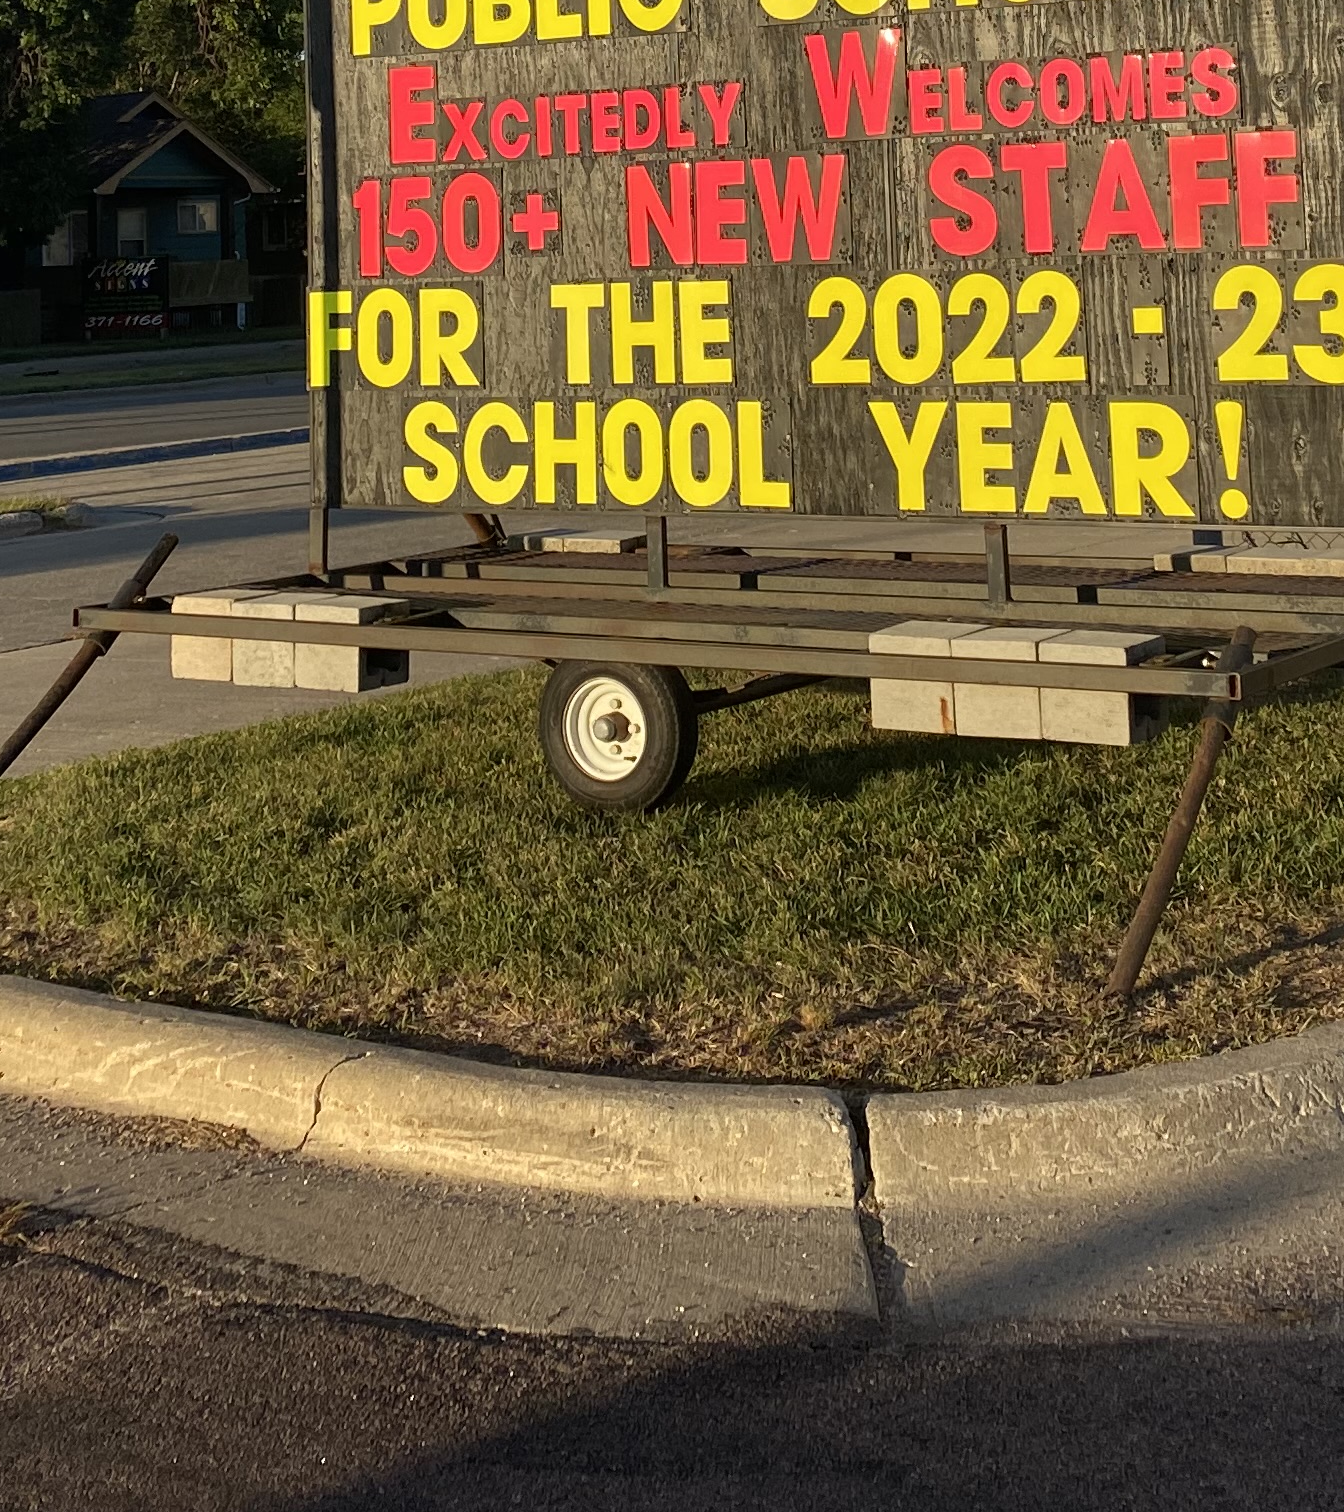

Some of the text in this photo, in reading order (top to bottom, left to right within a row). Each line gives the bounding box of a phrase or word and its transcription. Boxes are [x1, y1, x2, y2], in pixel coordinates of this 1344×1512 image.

[353, 131, 1297, 276] 150+ NEW STAFF
[84, 314, 163, 328] 371-1166
[87, 258, 158, 278] Accent
[309, 288, 478, 387] FOR
[551, 280, 733, 384] THE
[808, 271, 1086, 384] 2022
[404, 399, 1249, 519] SCHOOL YEAR!
